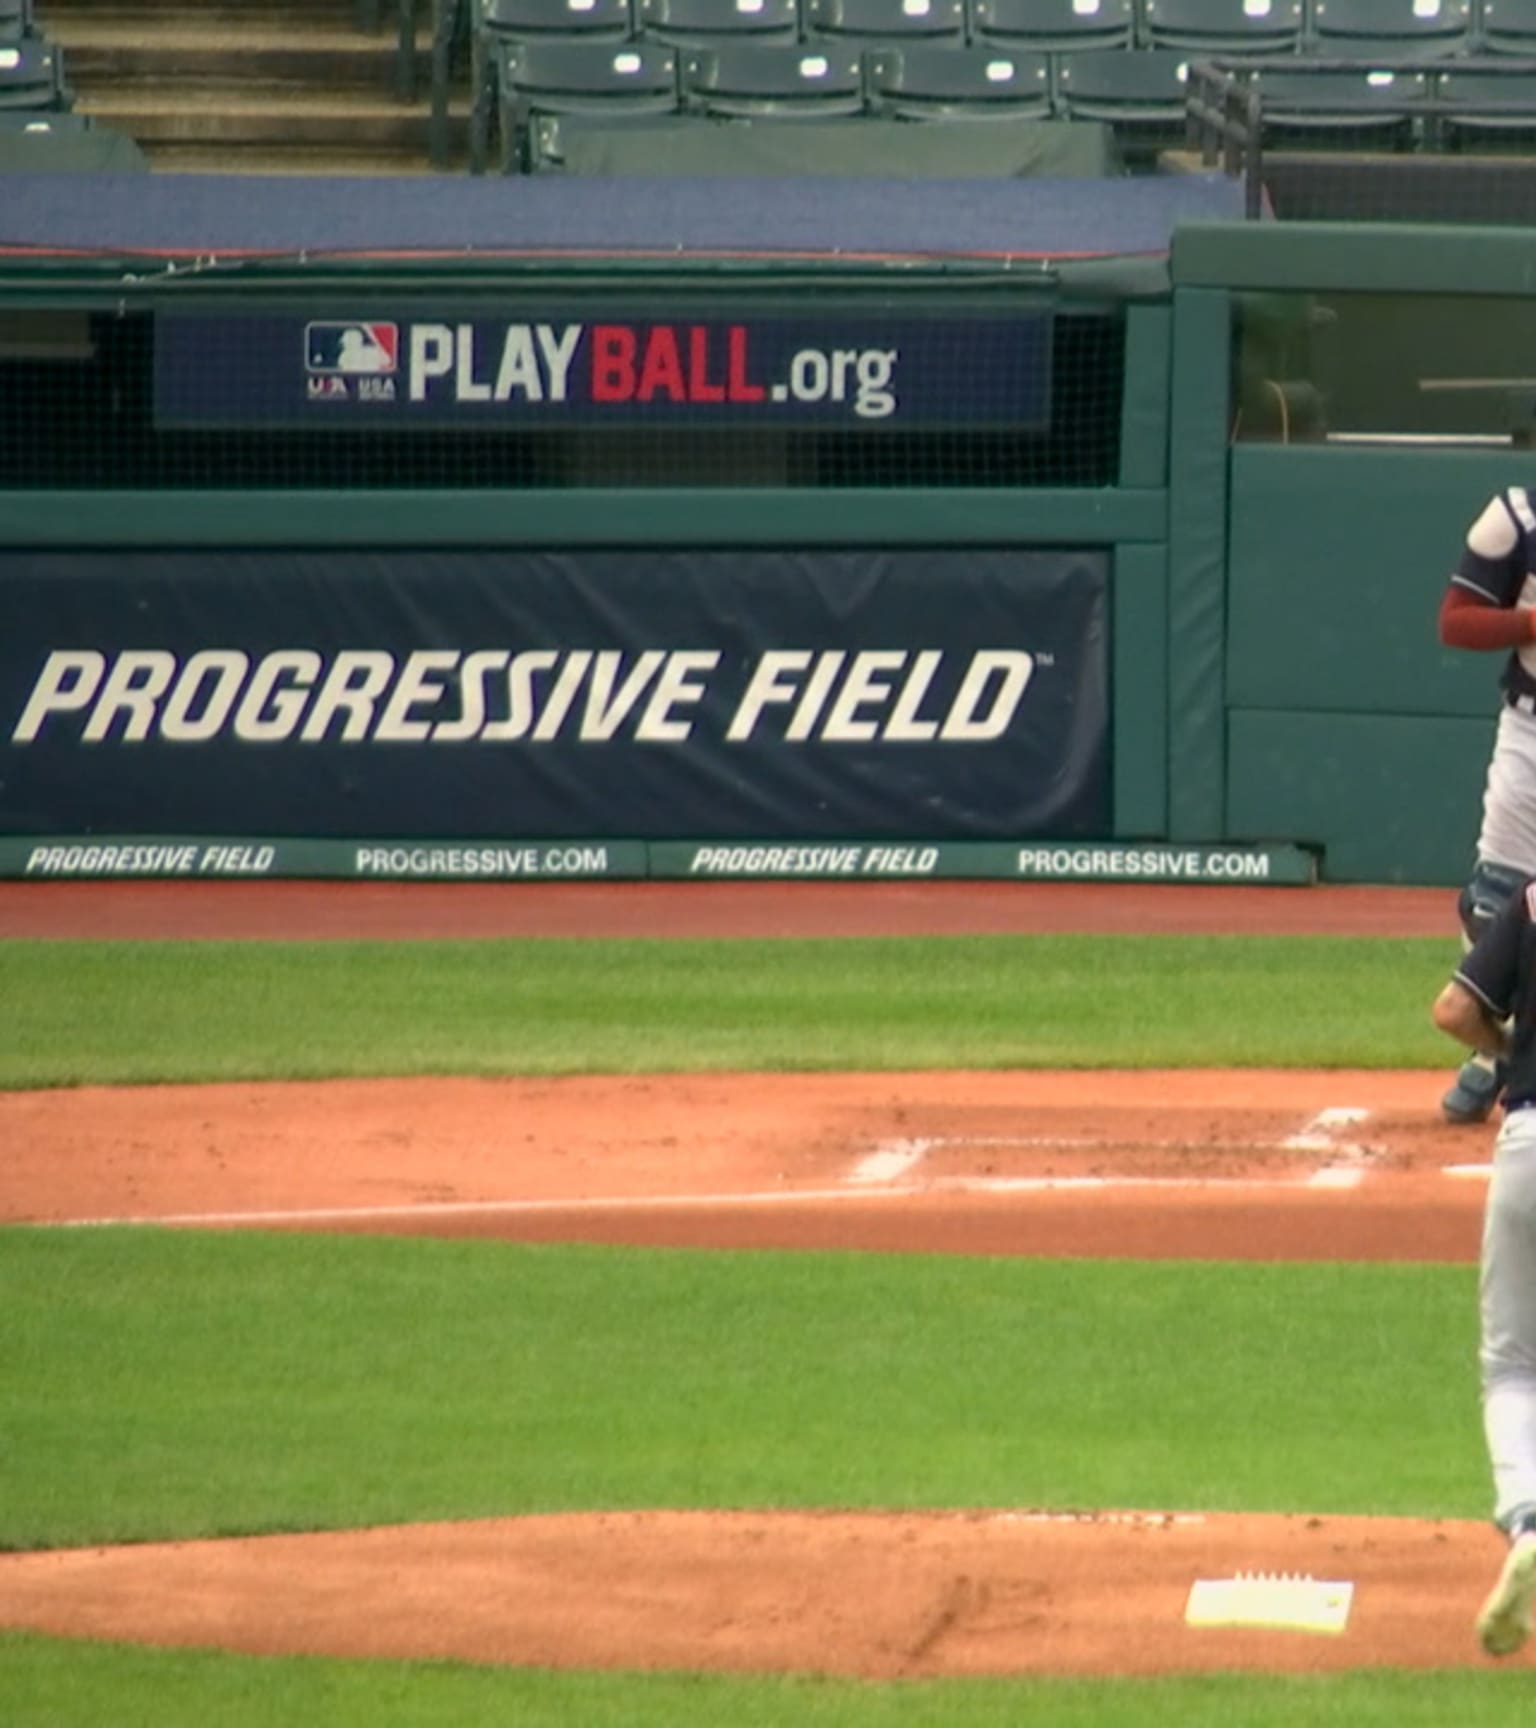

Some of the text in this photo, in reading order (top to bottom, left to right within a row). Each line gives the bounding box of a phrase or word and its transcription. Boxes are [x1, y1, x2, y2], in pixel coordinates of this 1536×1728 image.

[12, 650, 721, 743] PROGRESSIVE
[725, 650, 1034, 742] FIELD
[26, 846, 275, 873] PROGRESSIVE FIELD
[356, 847, 608, 873] PROGRESSIVE.COM
[690, 846, 939, 873] PROGRESSIVE FIELD
[1018, 848, 1269, 877] PROGRESSIVE.COM
